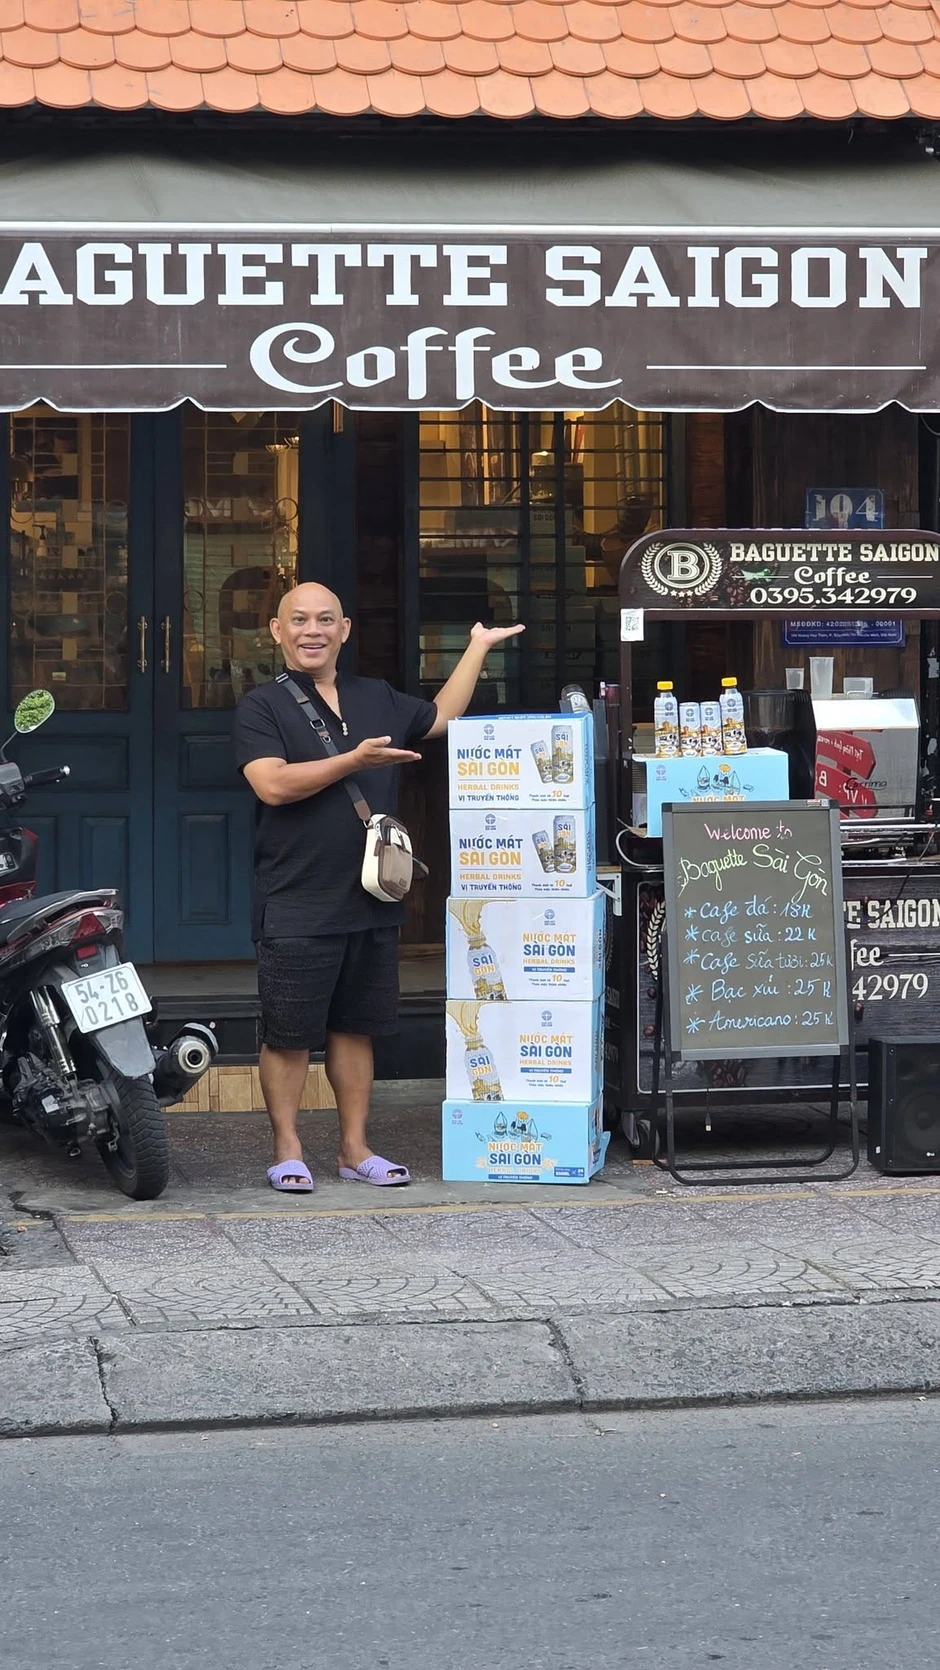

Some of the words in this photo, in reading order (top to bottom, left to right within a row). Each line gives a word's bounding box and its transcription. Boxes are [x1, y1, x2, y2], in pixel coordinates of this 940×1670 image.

[545, 246, 928, 308] SAIGON
[249, 321, 623, 400] Coffee
[812, 493, 879, 522] 104
[730, 543, 852, 562] BAGUETTE
[860, 543, 939, 562] SAIGON
[794, 566, 872, 586] Coffee
[750, 587, 917, 604] 0395.342979
[495, 745, 522, 759] MÁT
[457, 758, 482, 776] SÀI
[487, 758, 519, 776] GÒN
[704, 823, 771, 840] Welcome
[497, 835, 524, 849] MÁT
[459, 848, 484, 866] SÀI
[489, 848, 521, 866] GÒN
[678, 849, 748, 897] Baguette
[753, 844, 789, 873] Sài
[791, 851, 827, 903] Gòn
[700, 900, 740, 924] Cafe
[523, 941, 545, 956] SÀI
[548, 941, 575, 956] GÒN
[473, 954, 493, 967] SÀI
[700, 952, 740, 975] Cafe
[74, 971, 129, 1004] 54-Z6
[711, 979, 747, 1003] Bạc
[852, 973, 929, 1000] 42979
[84, 992, 140, 1026] 0218
[520, 1042, 541, 1057] SÀI
[545, 1042, 572, 1057] GÒN
[470, 1055, 490, 1068] SÀI
[489, 1150, 510, 1165] SÀI
[514, 1150, 541, 1165] GÒN
